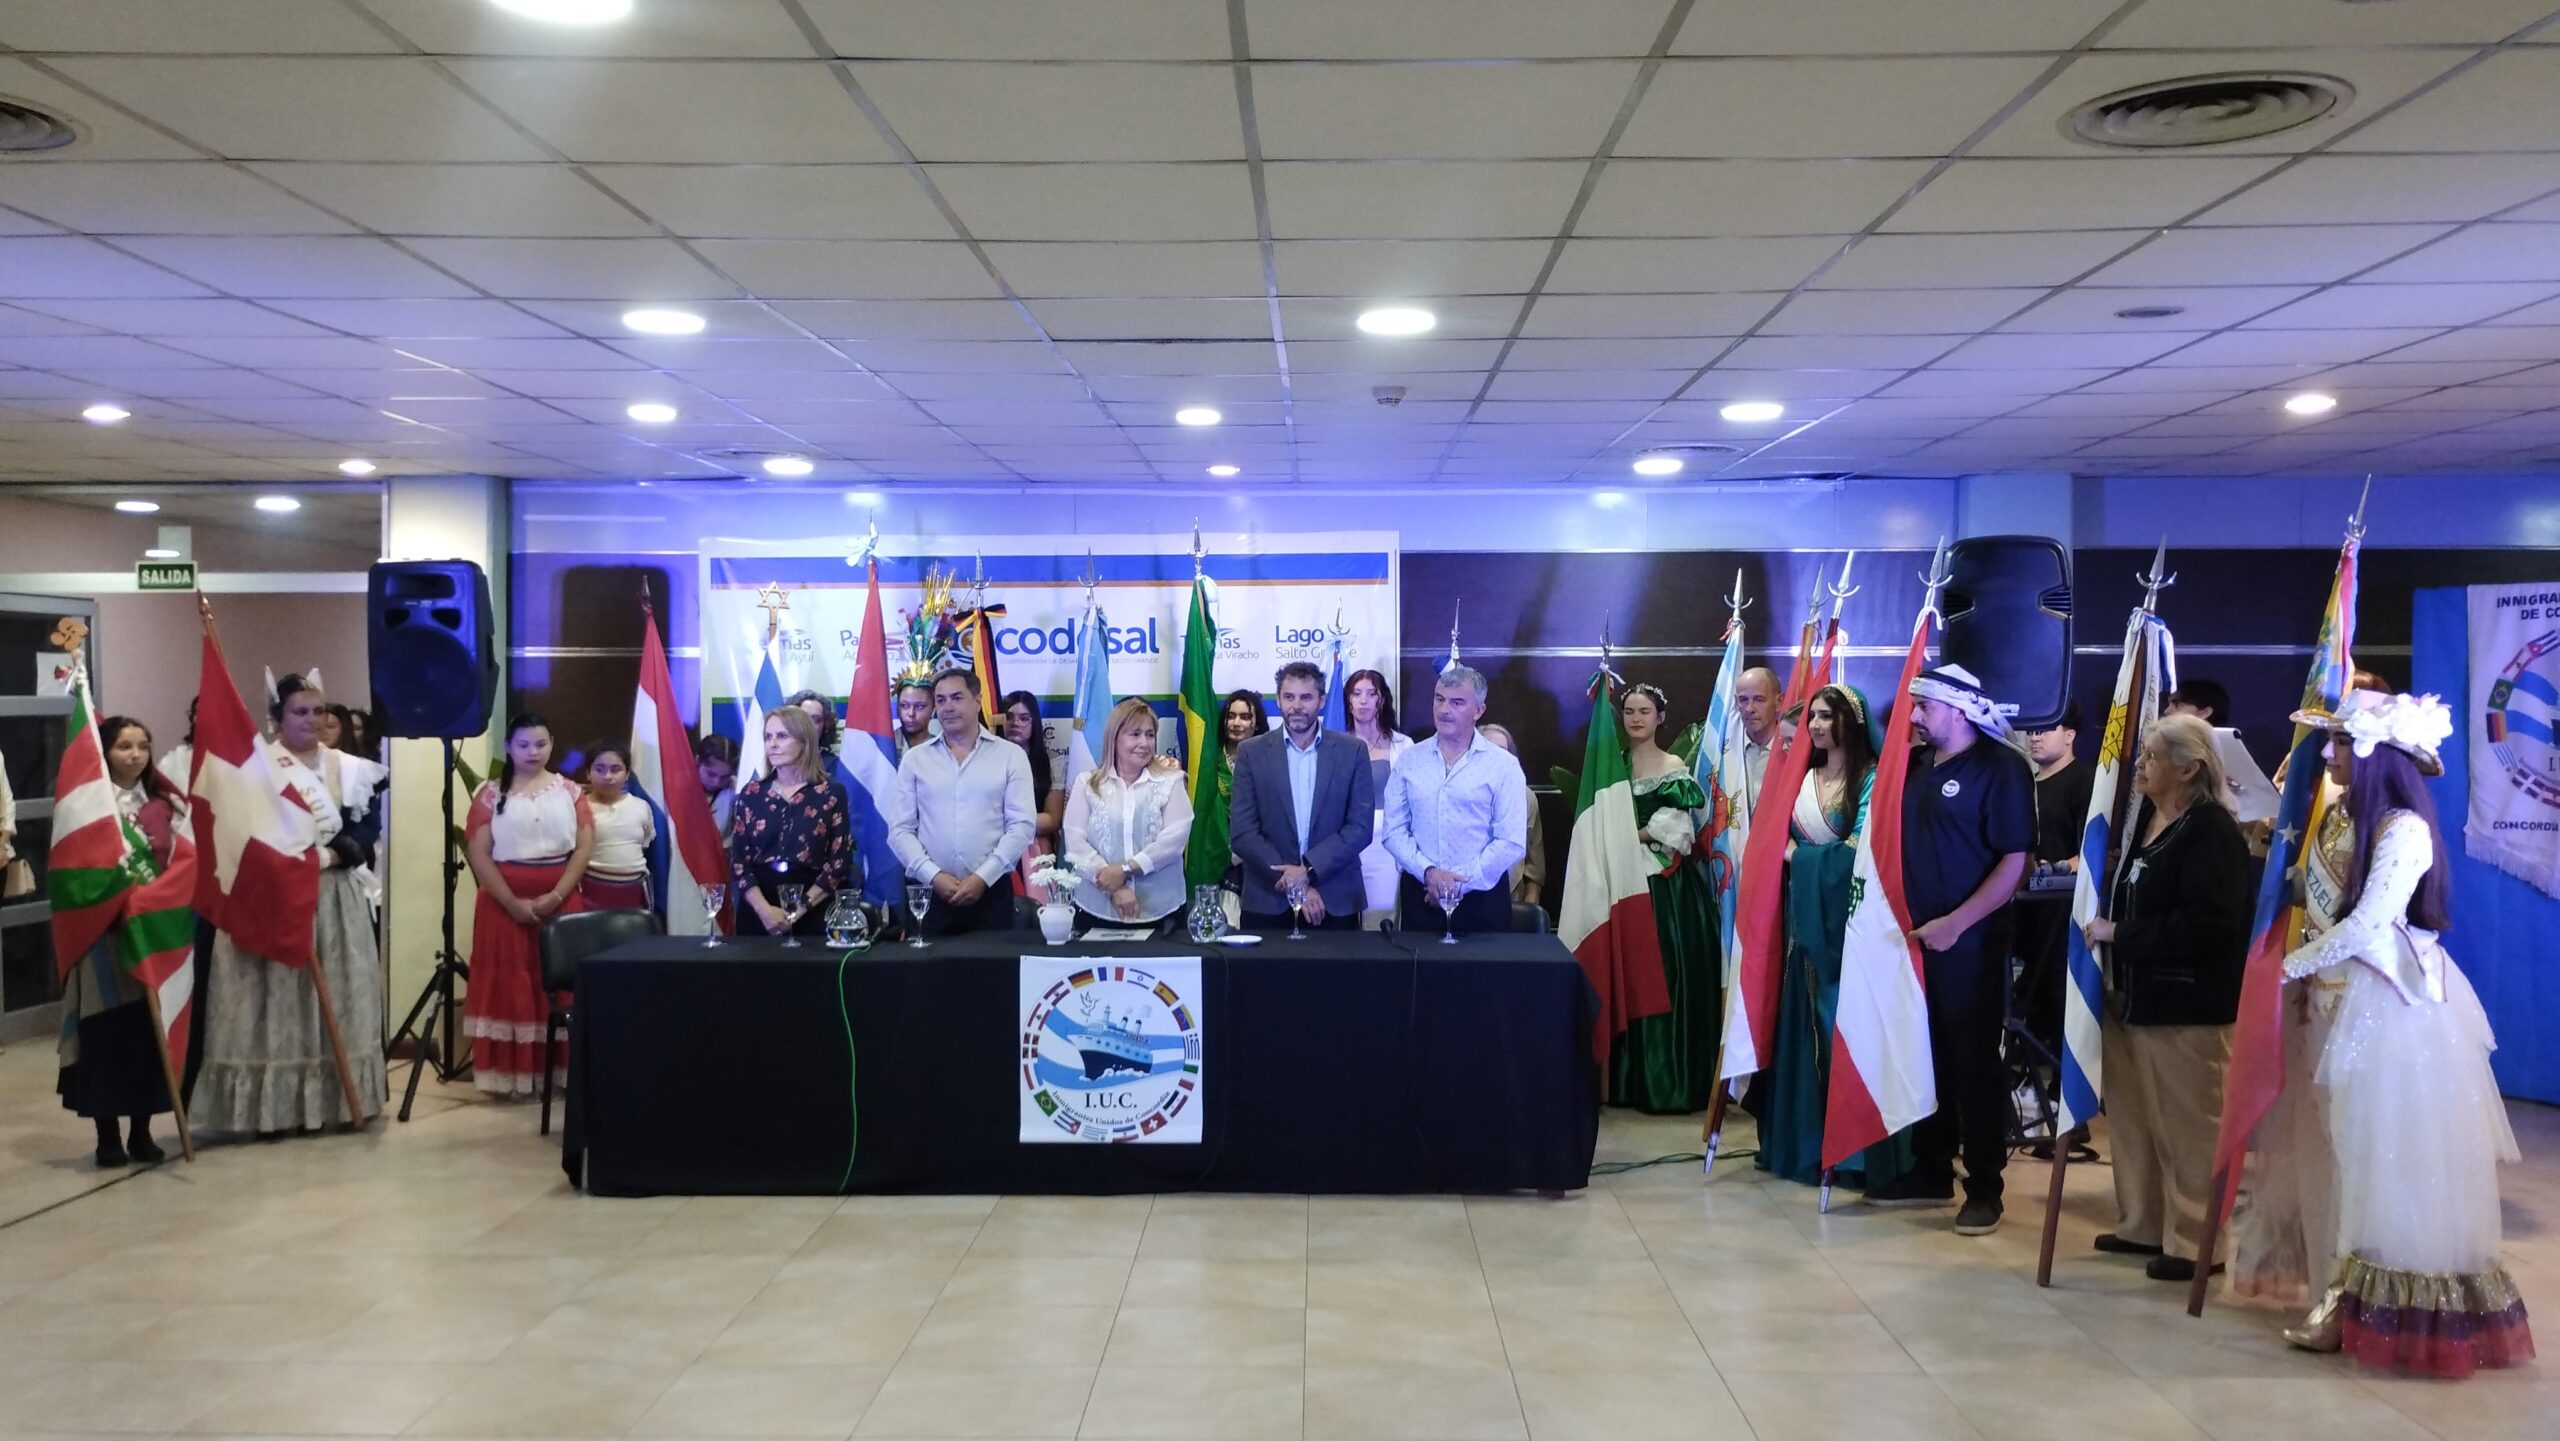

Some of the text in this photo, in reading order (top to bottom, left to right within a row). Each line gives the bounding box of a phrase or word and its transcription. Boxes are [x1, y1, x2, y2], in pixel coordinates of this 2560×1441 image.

[141, 568, 192, 585] SALIDA
[2496, 592, 2560, 609] INMIGRA
[2521, 608, 2540, 620] DE
[995, 617, 1160, 655] codsal
[1275, 625, 1325, 647] Lago
[1225, 650, 1260, 660] Viracho
[1275, 646, 1308, 659] Salto
[300, 785, 337, 838] SUIZ
[1085, 1092, 1138, 1109] I.U.C.
